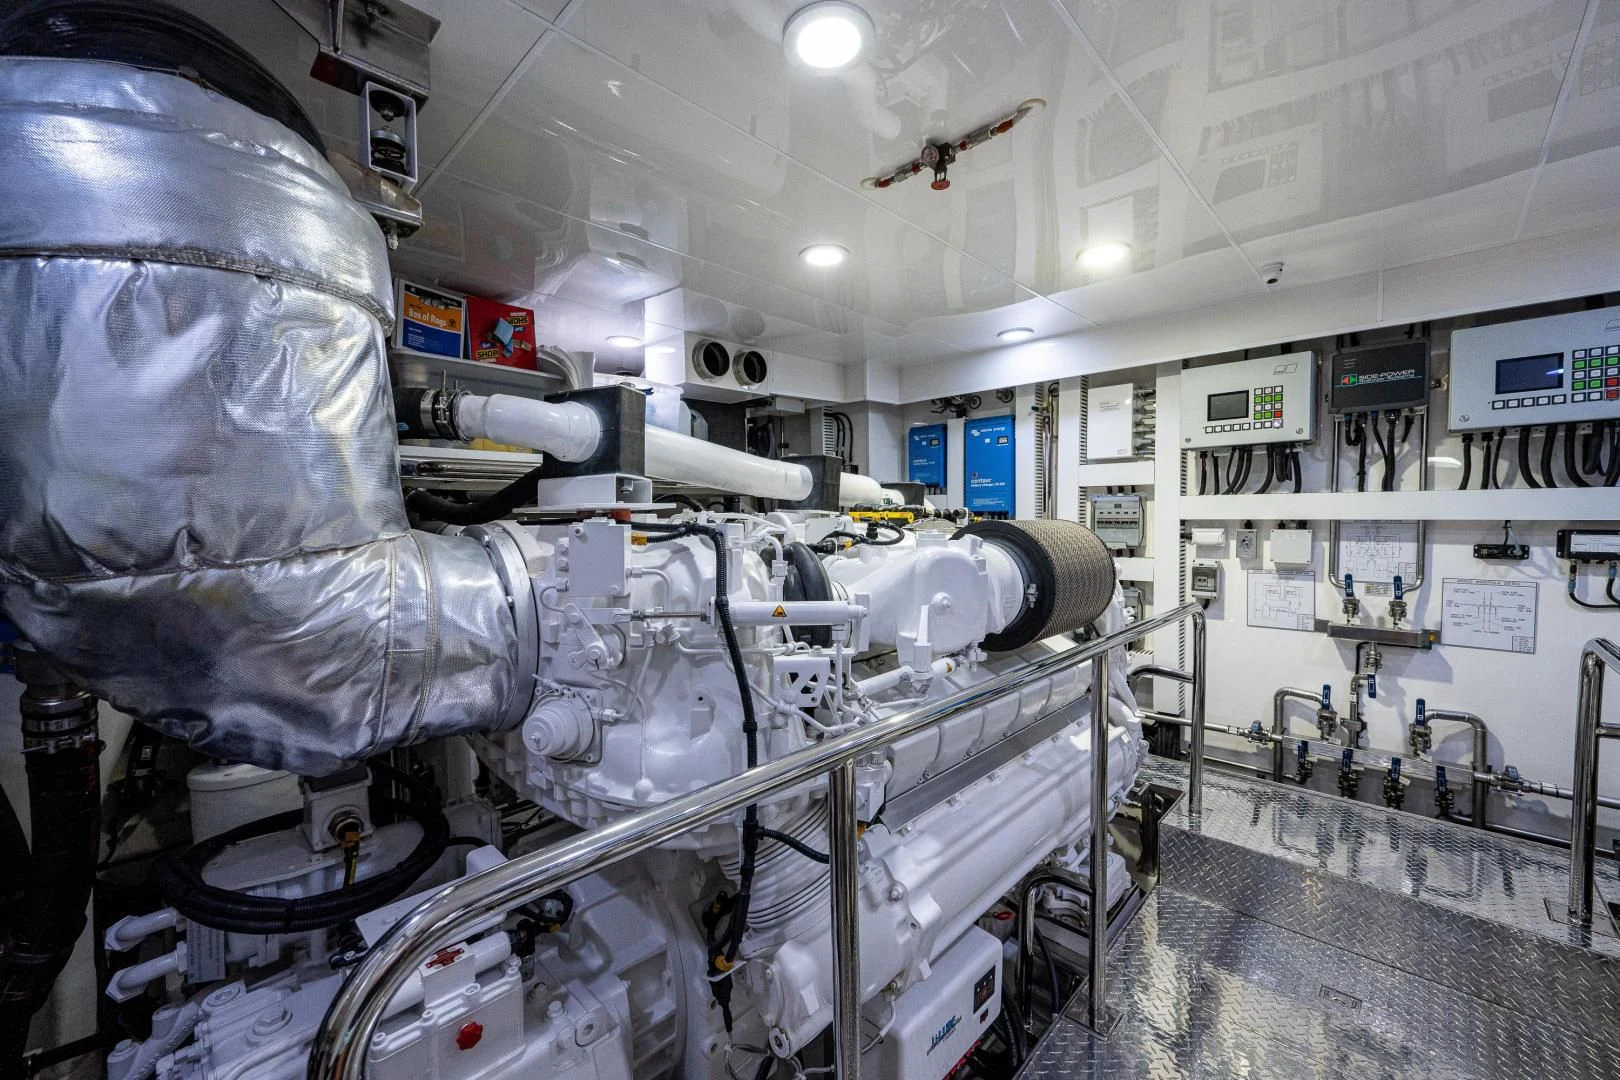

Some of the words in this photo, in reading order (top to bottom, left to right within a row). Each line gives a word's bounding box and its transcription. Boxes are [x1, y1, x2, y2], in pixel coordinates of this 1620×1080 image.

[408, 308, 422, 320] Box
[422, 312, 430, 321] of
[430, 314, 447, 327] Rags
[477, 349, 498, 359] SHOP
